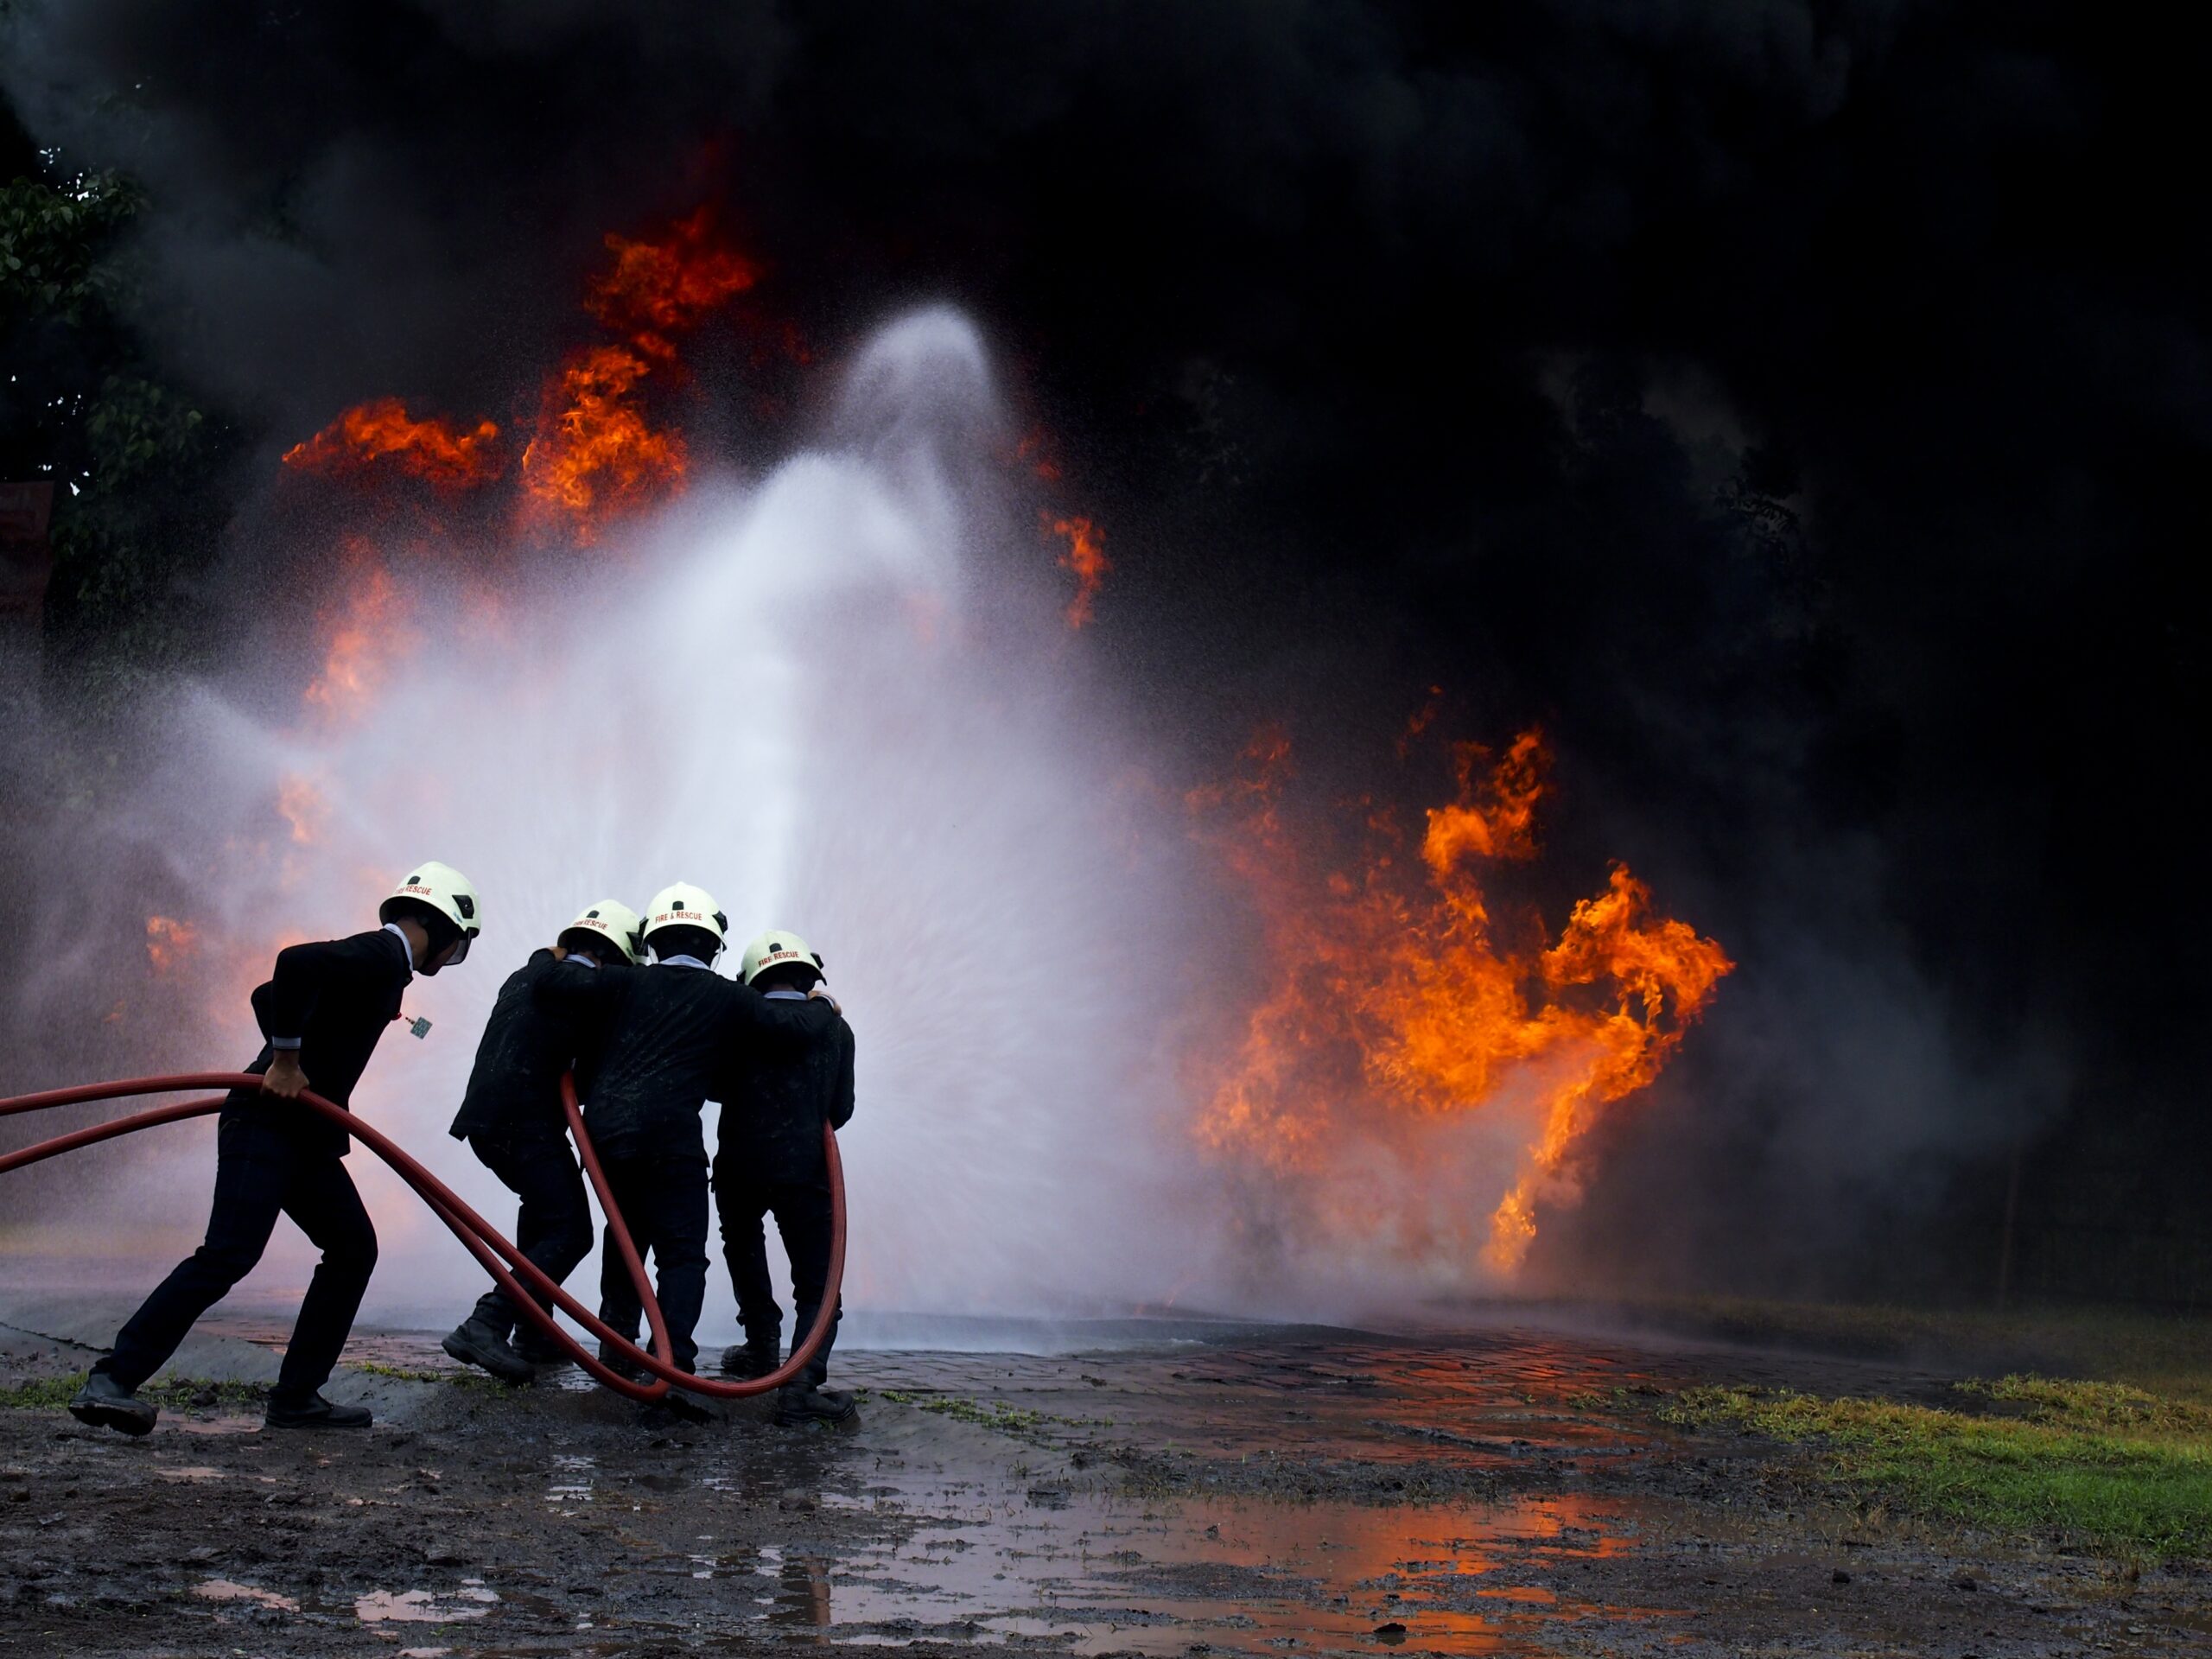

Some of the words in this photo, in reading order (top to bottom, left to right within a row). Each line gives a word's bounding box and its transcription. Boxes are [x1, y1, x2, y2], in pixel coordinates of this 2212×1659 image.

[405, 885, 432, 895] RESCUE
[655, 913, 668, 924] FIRE
[676, 911, 702, 921] RESCUE
[583, 918, 608, 930] RESCUE
[758, 956, 772, 967] FIRE
[773, 950, 799, 960] RESCUE
